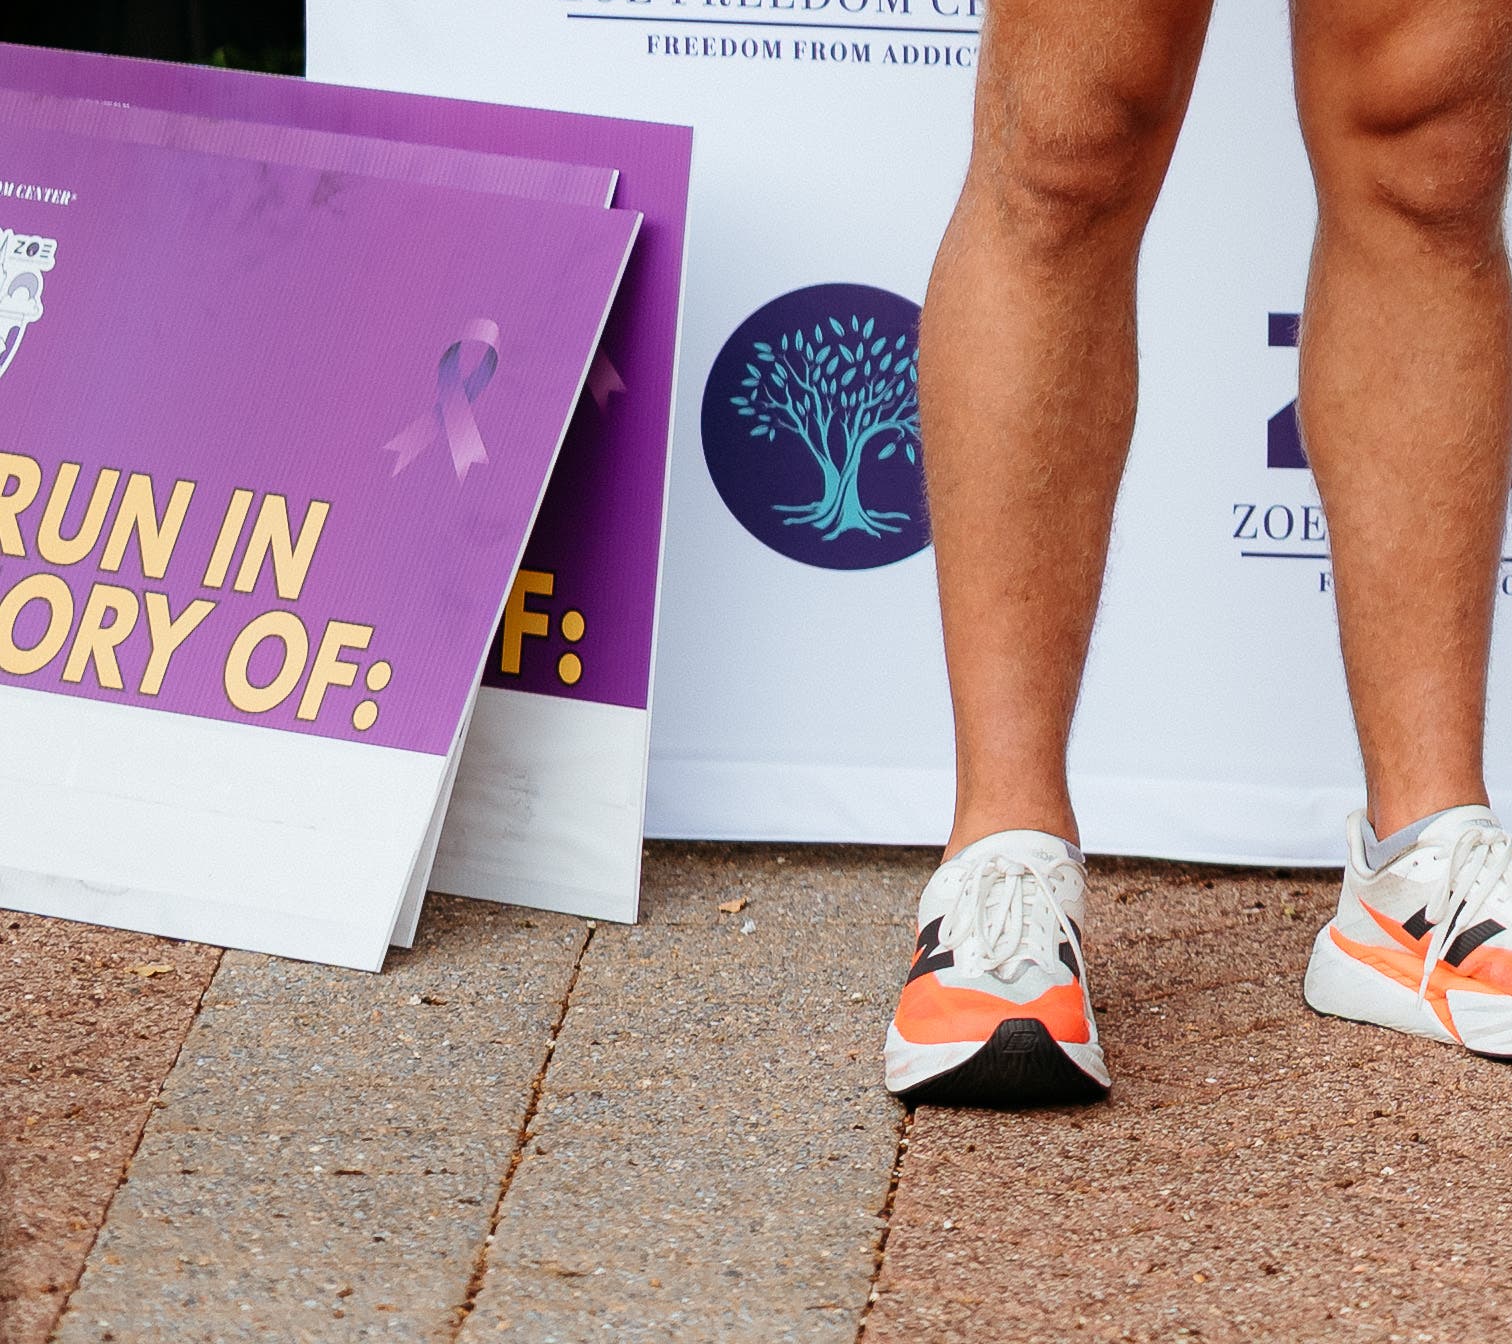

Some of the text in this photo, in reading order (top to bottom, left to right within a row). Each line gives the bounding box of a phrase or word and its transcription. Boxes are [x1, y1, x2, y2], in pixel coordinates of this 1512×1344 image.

[646, 34, 872, 64] FREEDOM FROM
[0, 451, 332, 602] RUN IN
[1231, 502, 1328, 542] ZOE
[222, 608, 395, 732] OF:
